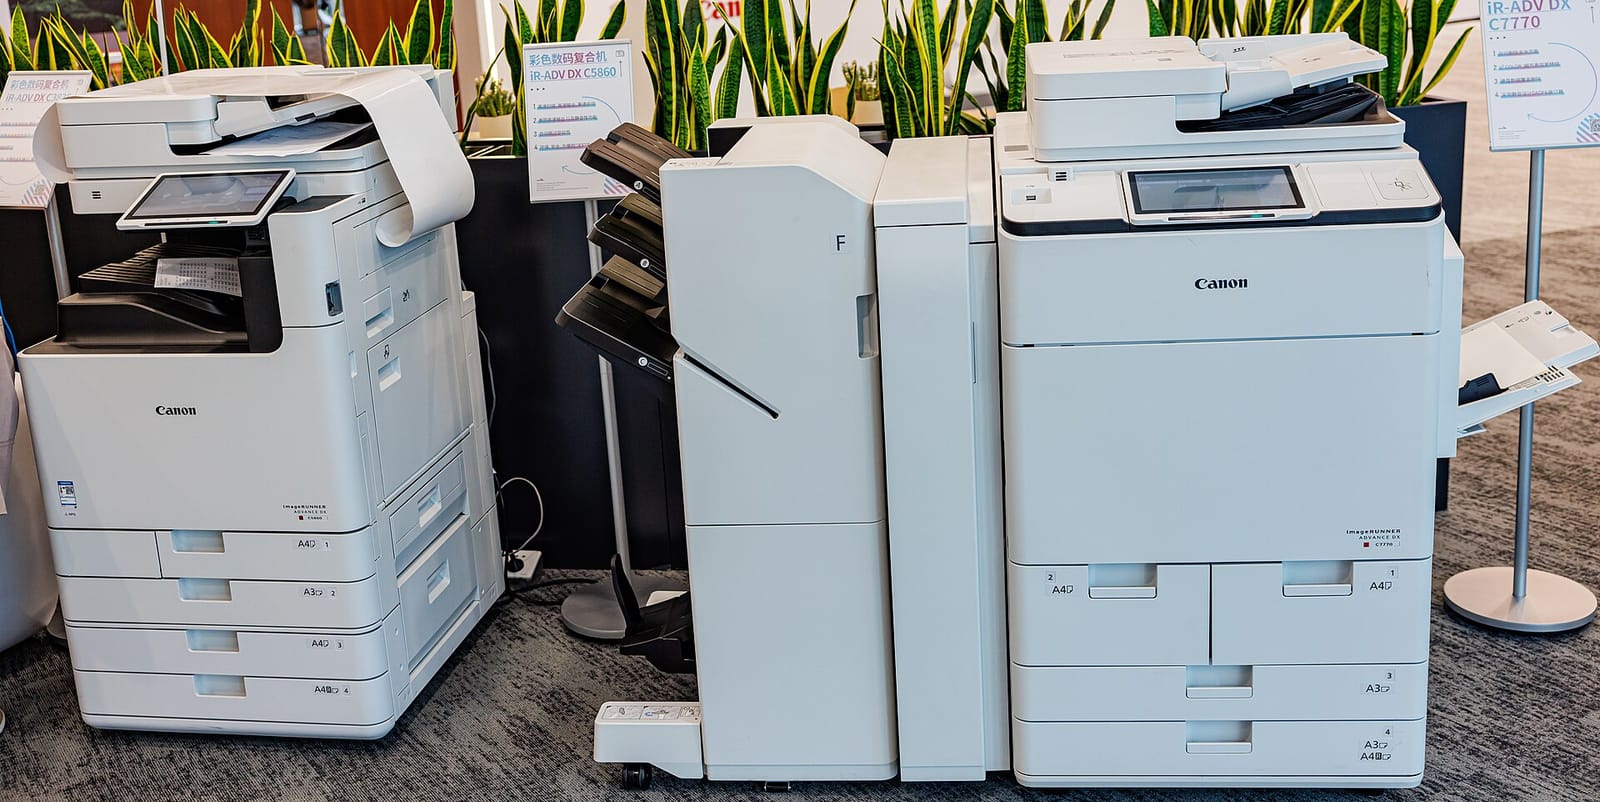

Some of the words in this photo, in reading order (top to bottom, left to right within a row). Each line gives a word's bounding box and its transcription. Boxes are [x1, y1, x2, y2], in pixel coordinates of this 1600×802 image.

[1488, 0, 1543, 14] iR-ADV
[1549, 0, 1571, 10] DX
[1489, 16, 1540, 31] C7770
[529, 50, 607, 66] 彩色数码复合机
[530, 69, 565, 81] iR-ADV
[567, 68, 582, 79] DX
[583, 66, 616, 78] C5860
[34, 93, 46, 102] DX
[836, 234, 846, 251] F
[1194, 278, 1248, 290] Canon
[155, 405, 197, 416] Canon
[1387, 672, 1393, 680] 3
[1365, 683, 1381, 693] A3
[1384, 728, 1391, 736] 4
[1364, 740, 1379, 750] A3
